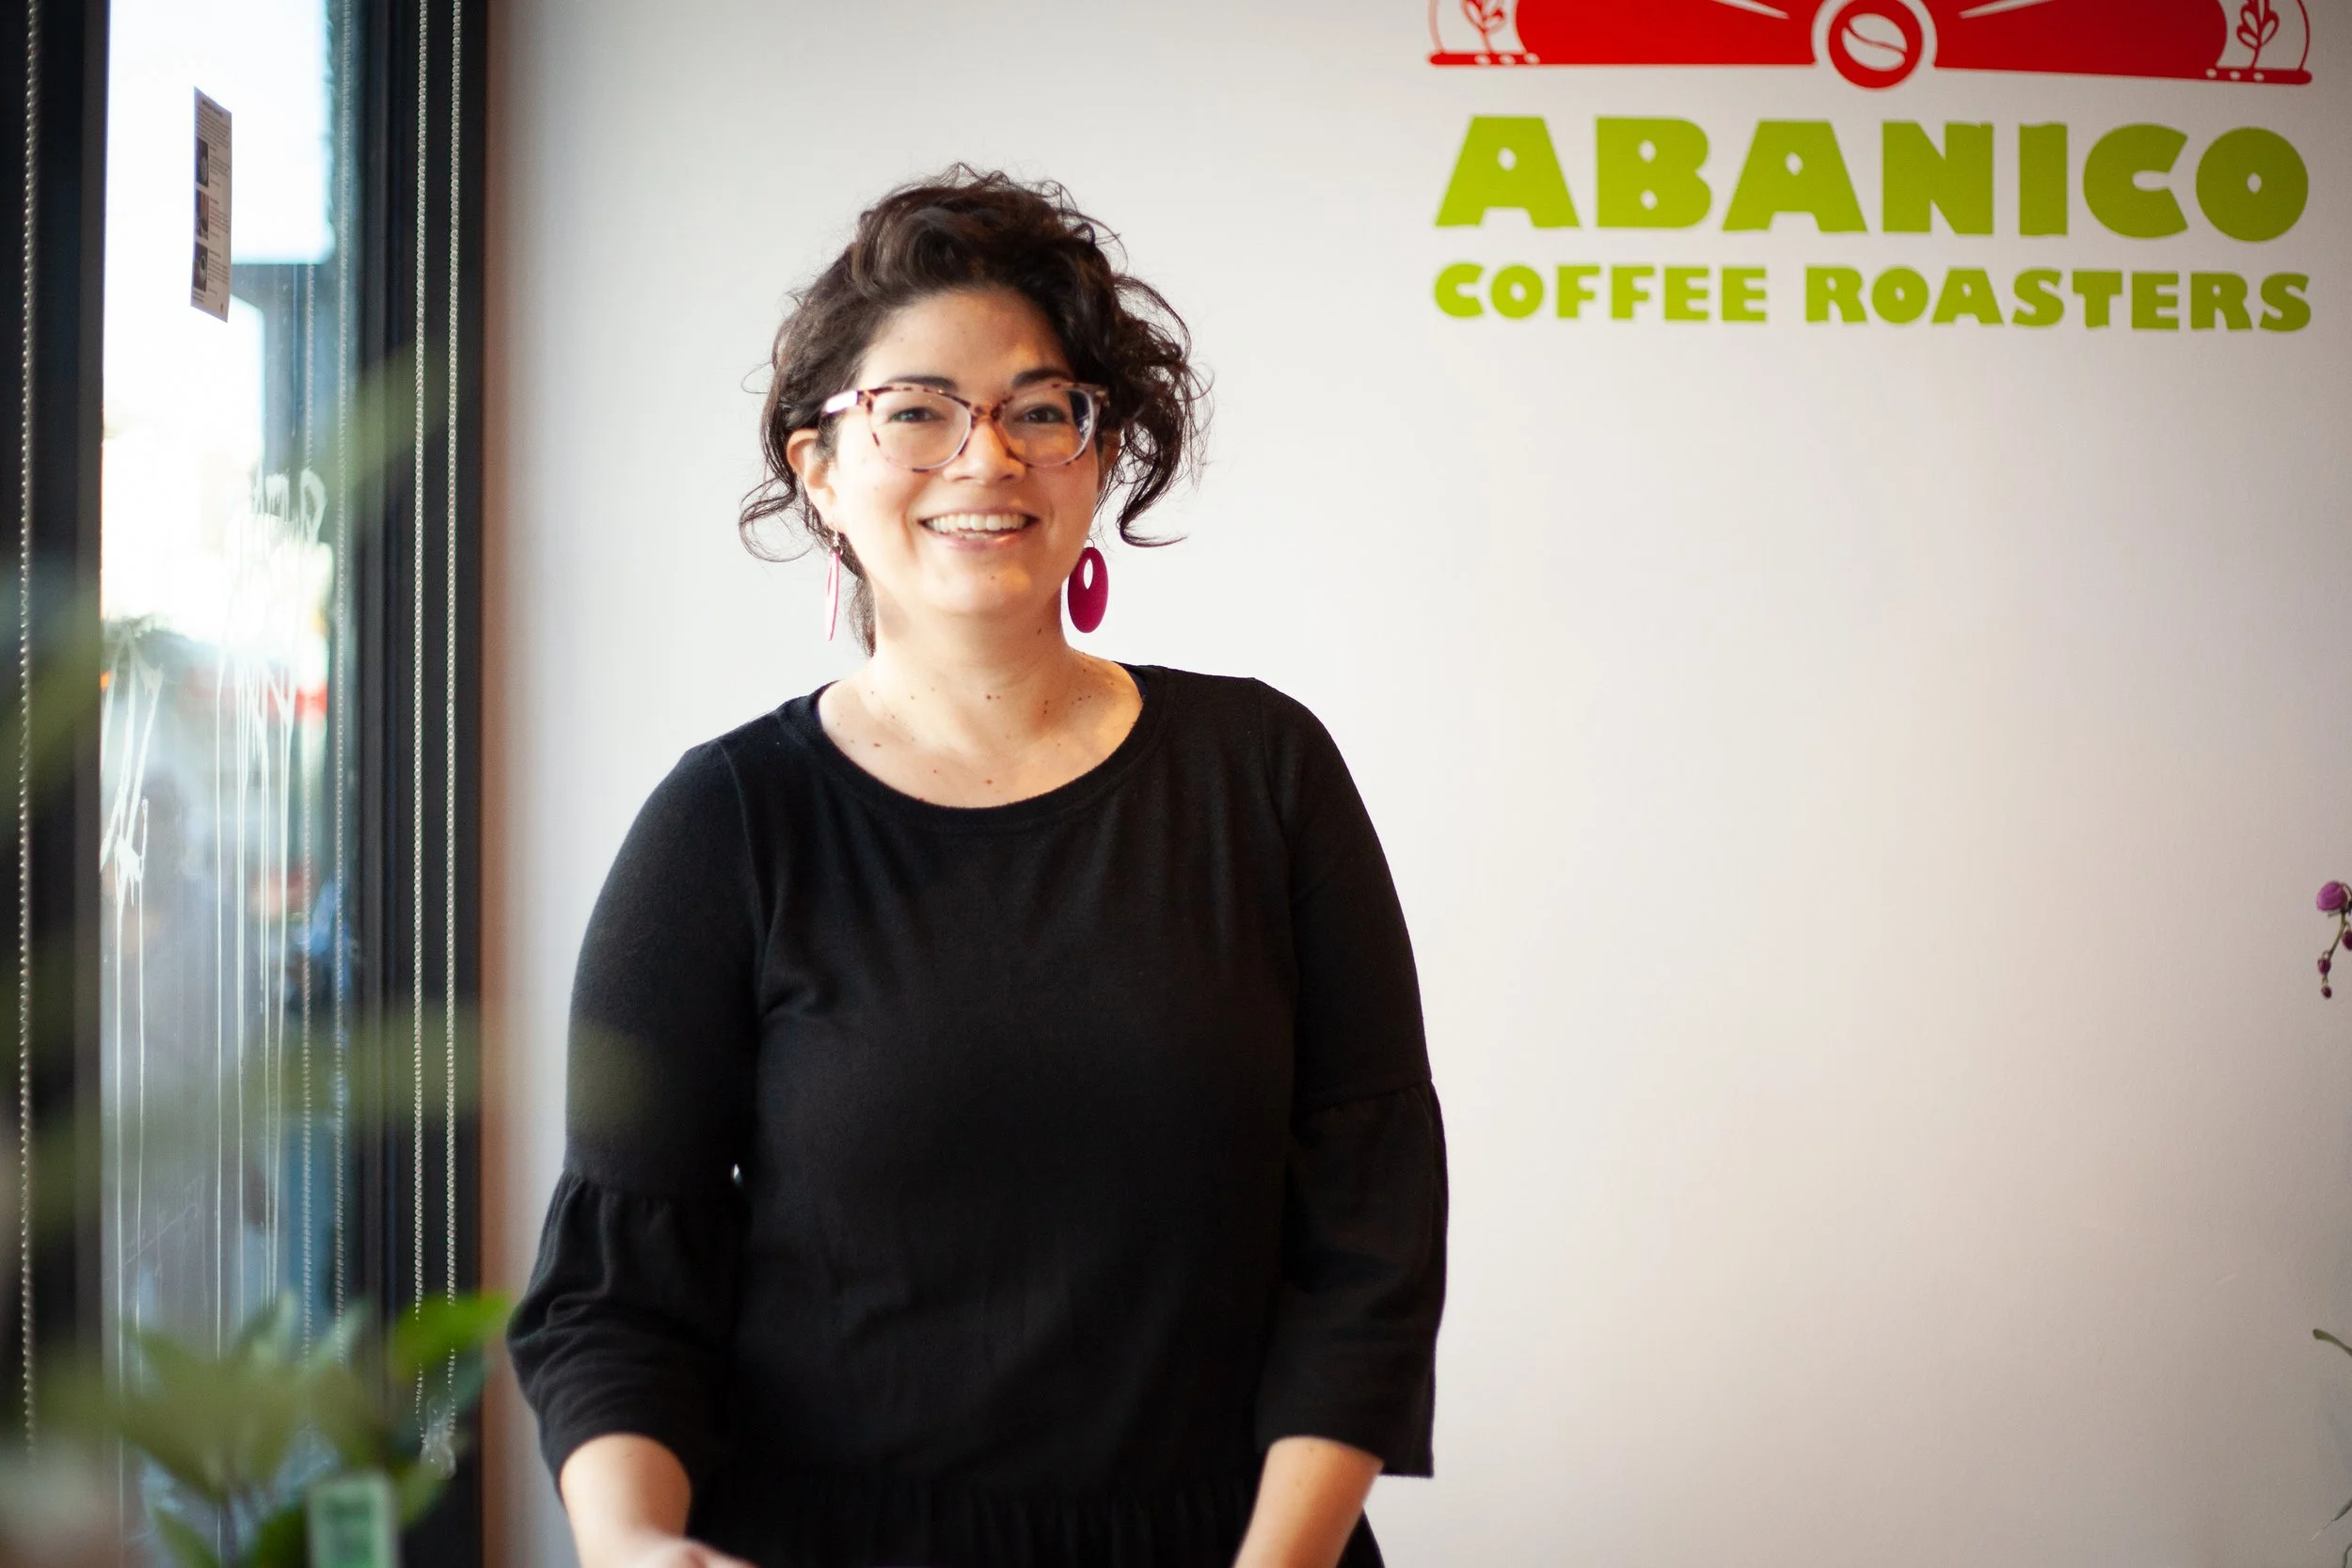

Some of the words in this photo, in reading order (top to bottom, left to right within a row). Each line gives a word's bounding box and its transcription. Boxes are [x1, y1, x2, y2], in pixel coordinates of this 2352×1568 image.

[1435, 115, 2310, 242] ABANICO
[1433, 262, 1767, 323] COFFEE
[1804, 265, 2312, 333] ROASTERS
